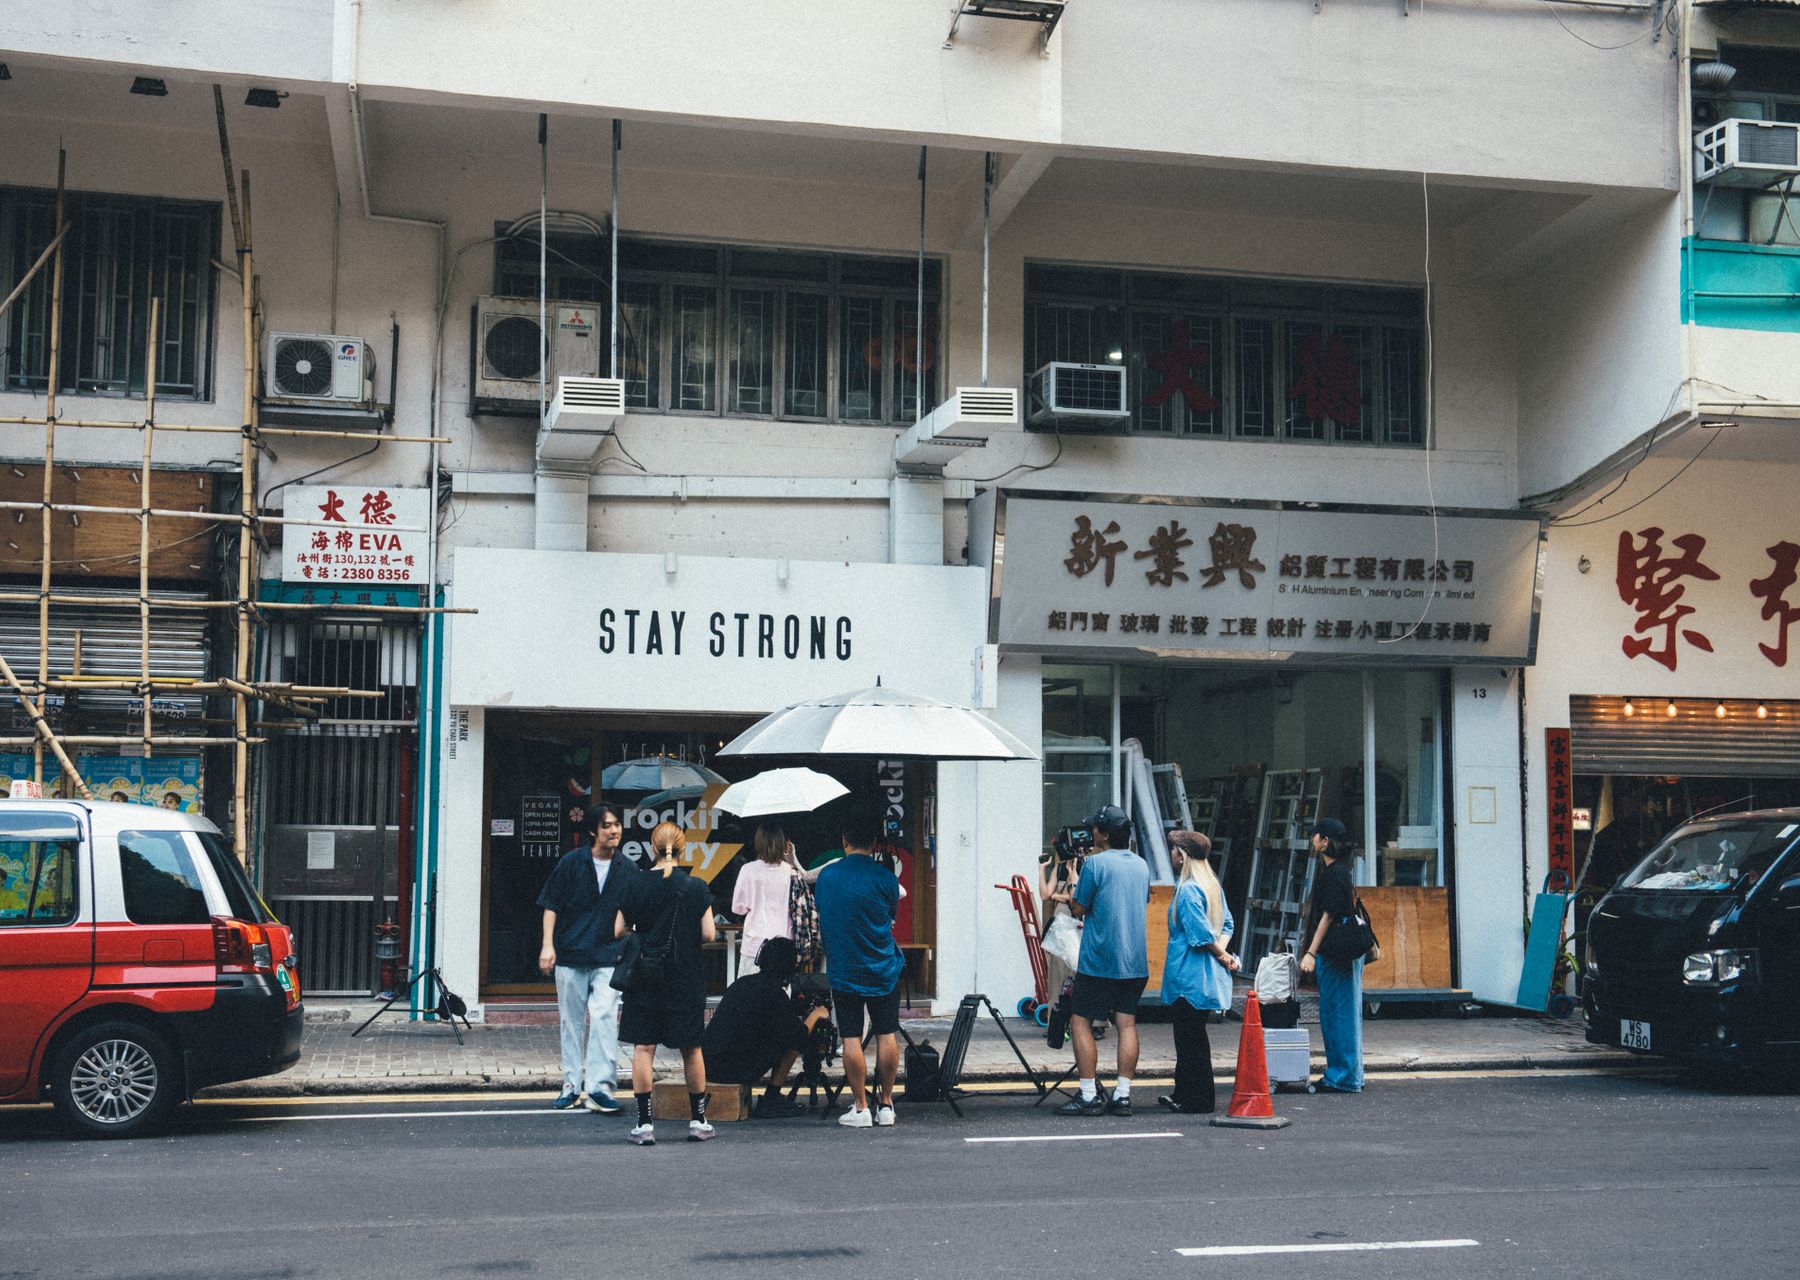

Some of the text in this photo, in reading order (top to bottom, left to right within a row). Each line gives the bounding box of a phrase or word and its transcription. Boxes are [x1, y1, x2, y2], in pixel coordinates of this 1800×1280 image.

[318, 490, 397, 526] 大德
[311, 530, 403, 553] 海棉 EVA
[1064, 515, 1266, 589] 新業興
[377, 568, 410, 580] 8356
[1279, 554, 1475, 583] 鋁質工程有限公司
[1301, 584, 1347, 596] Aluminium
[599, 608, 852, 661] STAY STRONG
[1048, 610, 1110, 633] 鋁門窗
[1120, 613, 1160, 634] 玻璃
[1170, 615, 1209, 636] 批發
[1219, 617, 1257, 637] 工程
[1267, 617, 1307, 638] 設計
[1472, 688, 1487, 699] 13
[459, 710, 469, 742] THE PARK
[621, 743, 706, 767] YEARS
[522, 845, 560, 857] YEARS
[1623, 1033, 1649, 1049] 4780
